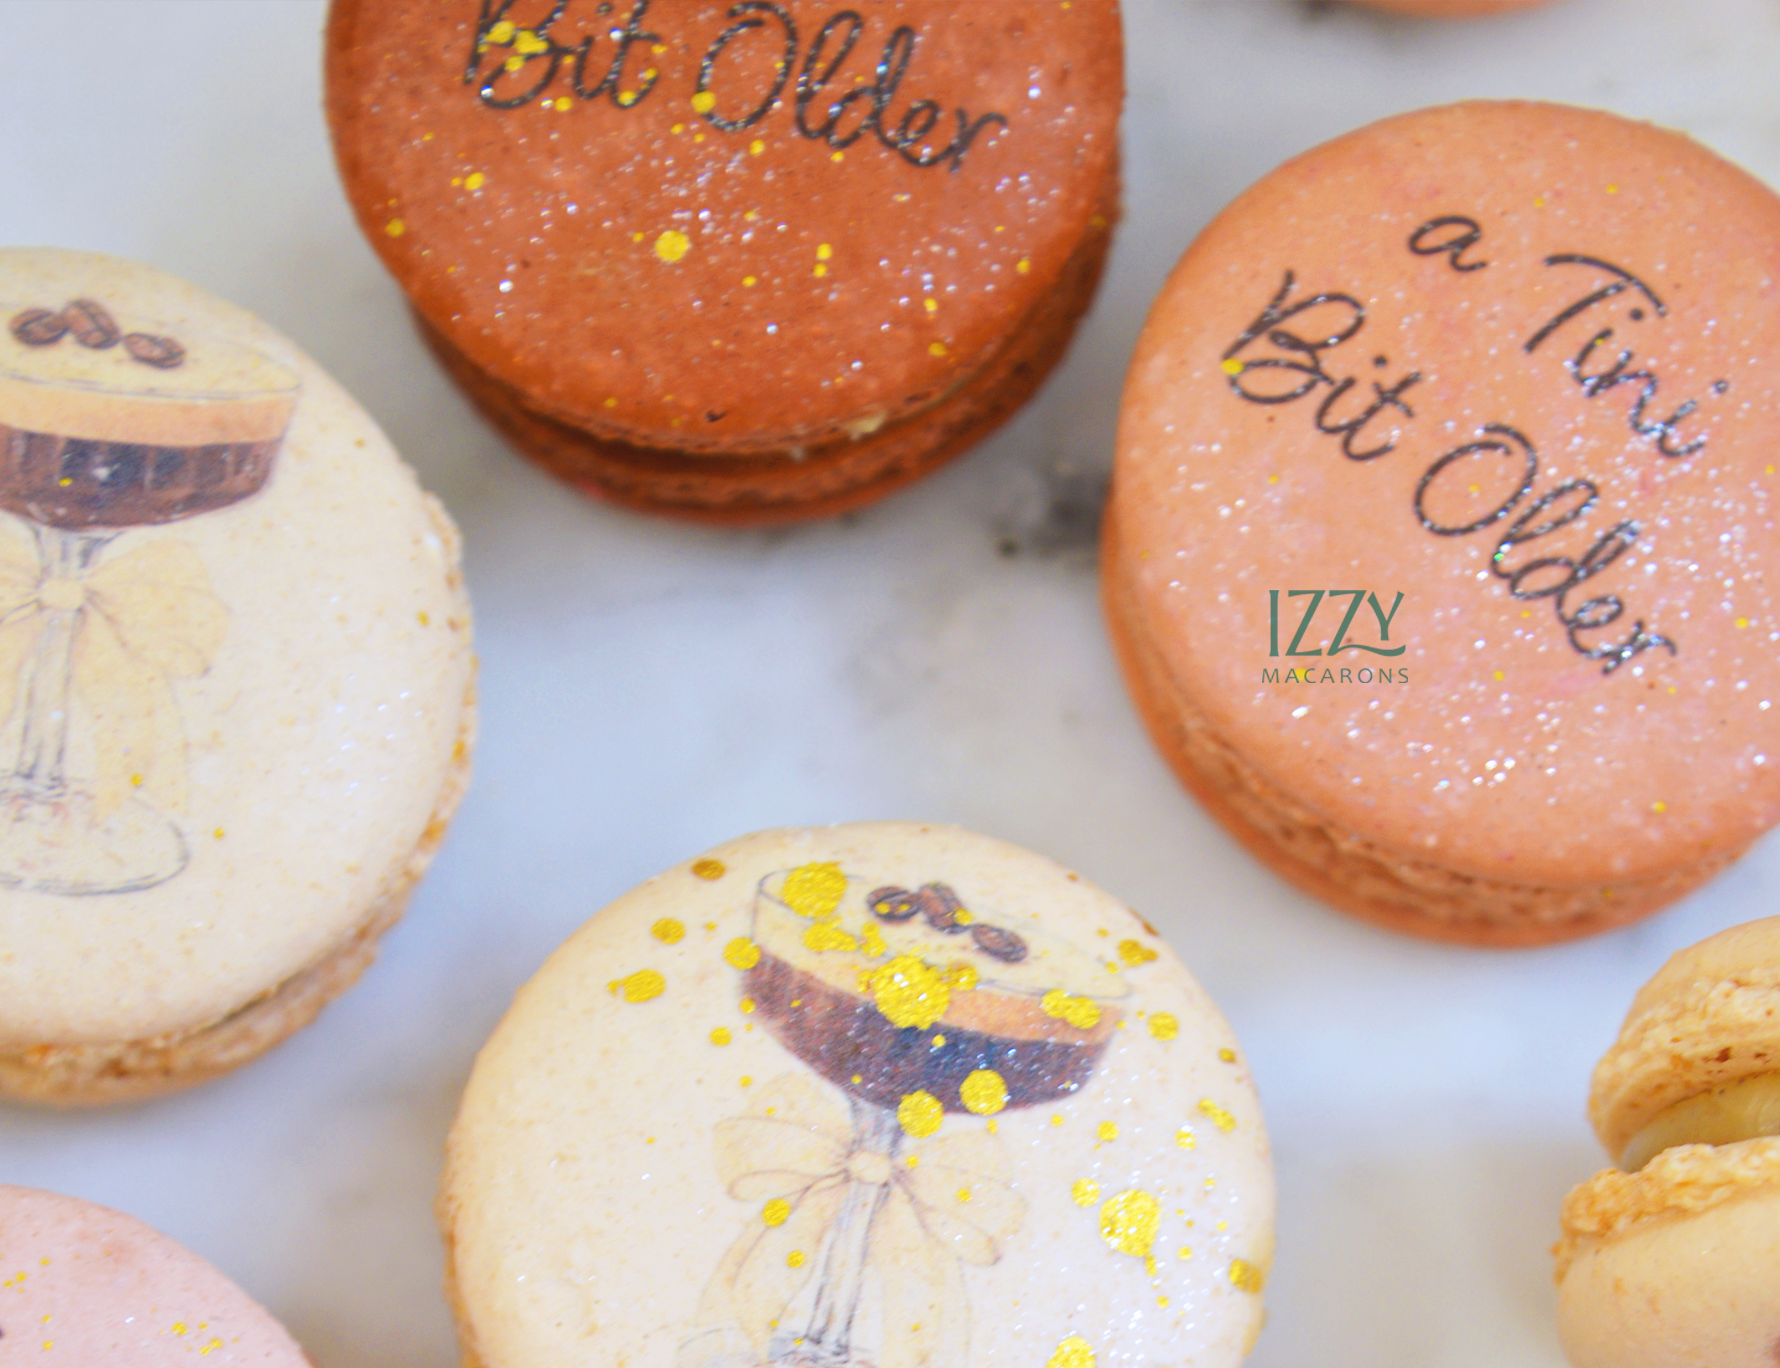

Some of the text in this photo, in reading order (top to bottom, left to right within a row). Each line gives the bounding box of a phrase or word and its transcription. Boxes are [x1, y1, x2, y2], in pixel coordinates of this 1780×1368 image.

[464, 0, 1008, 173] Bit Older
[1408, 215, 1729, 458] a Tini
[1220, 269, 1677, 675] Bit Older
